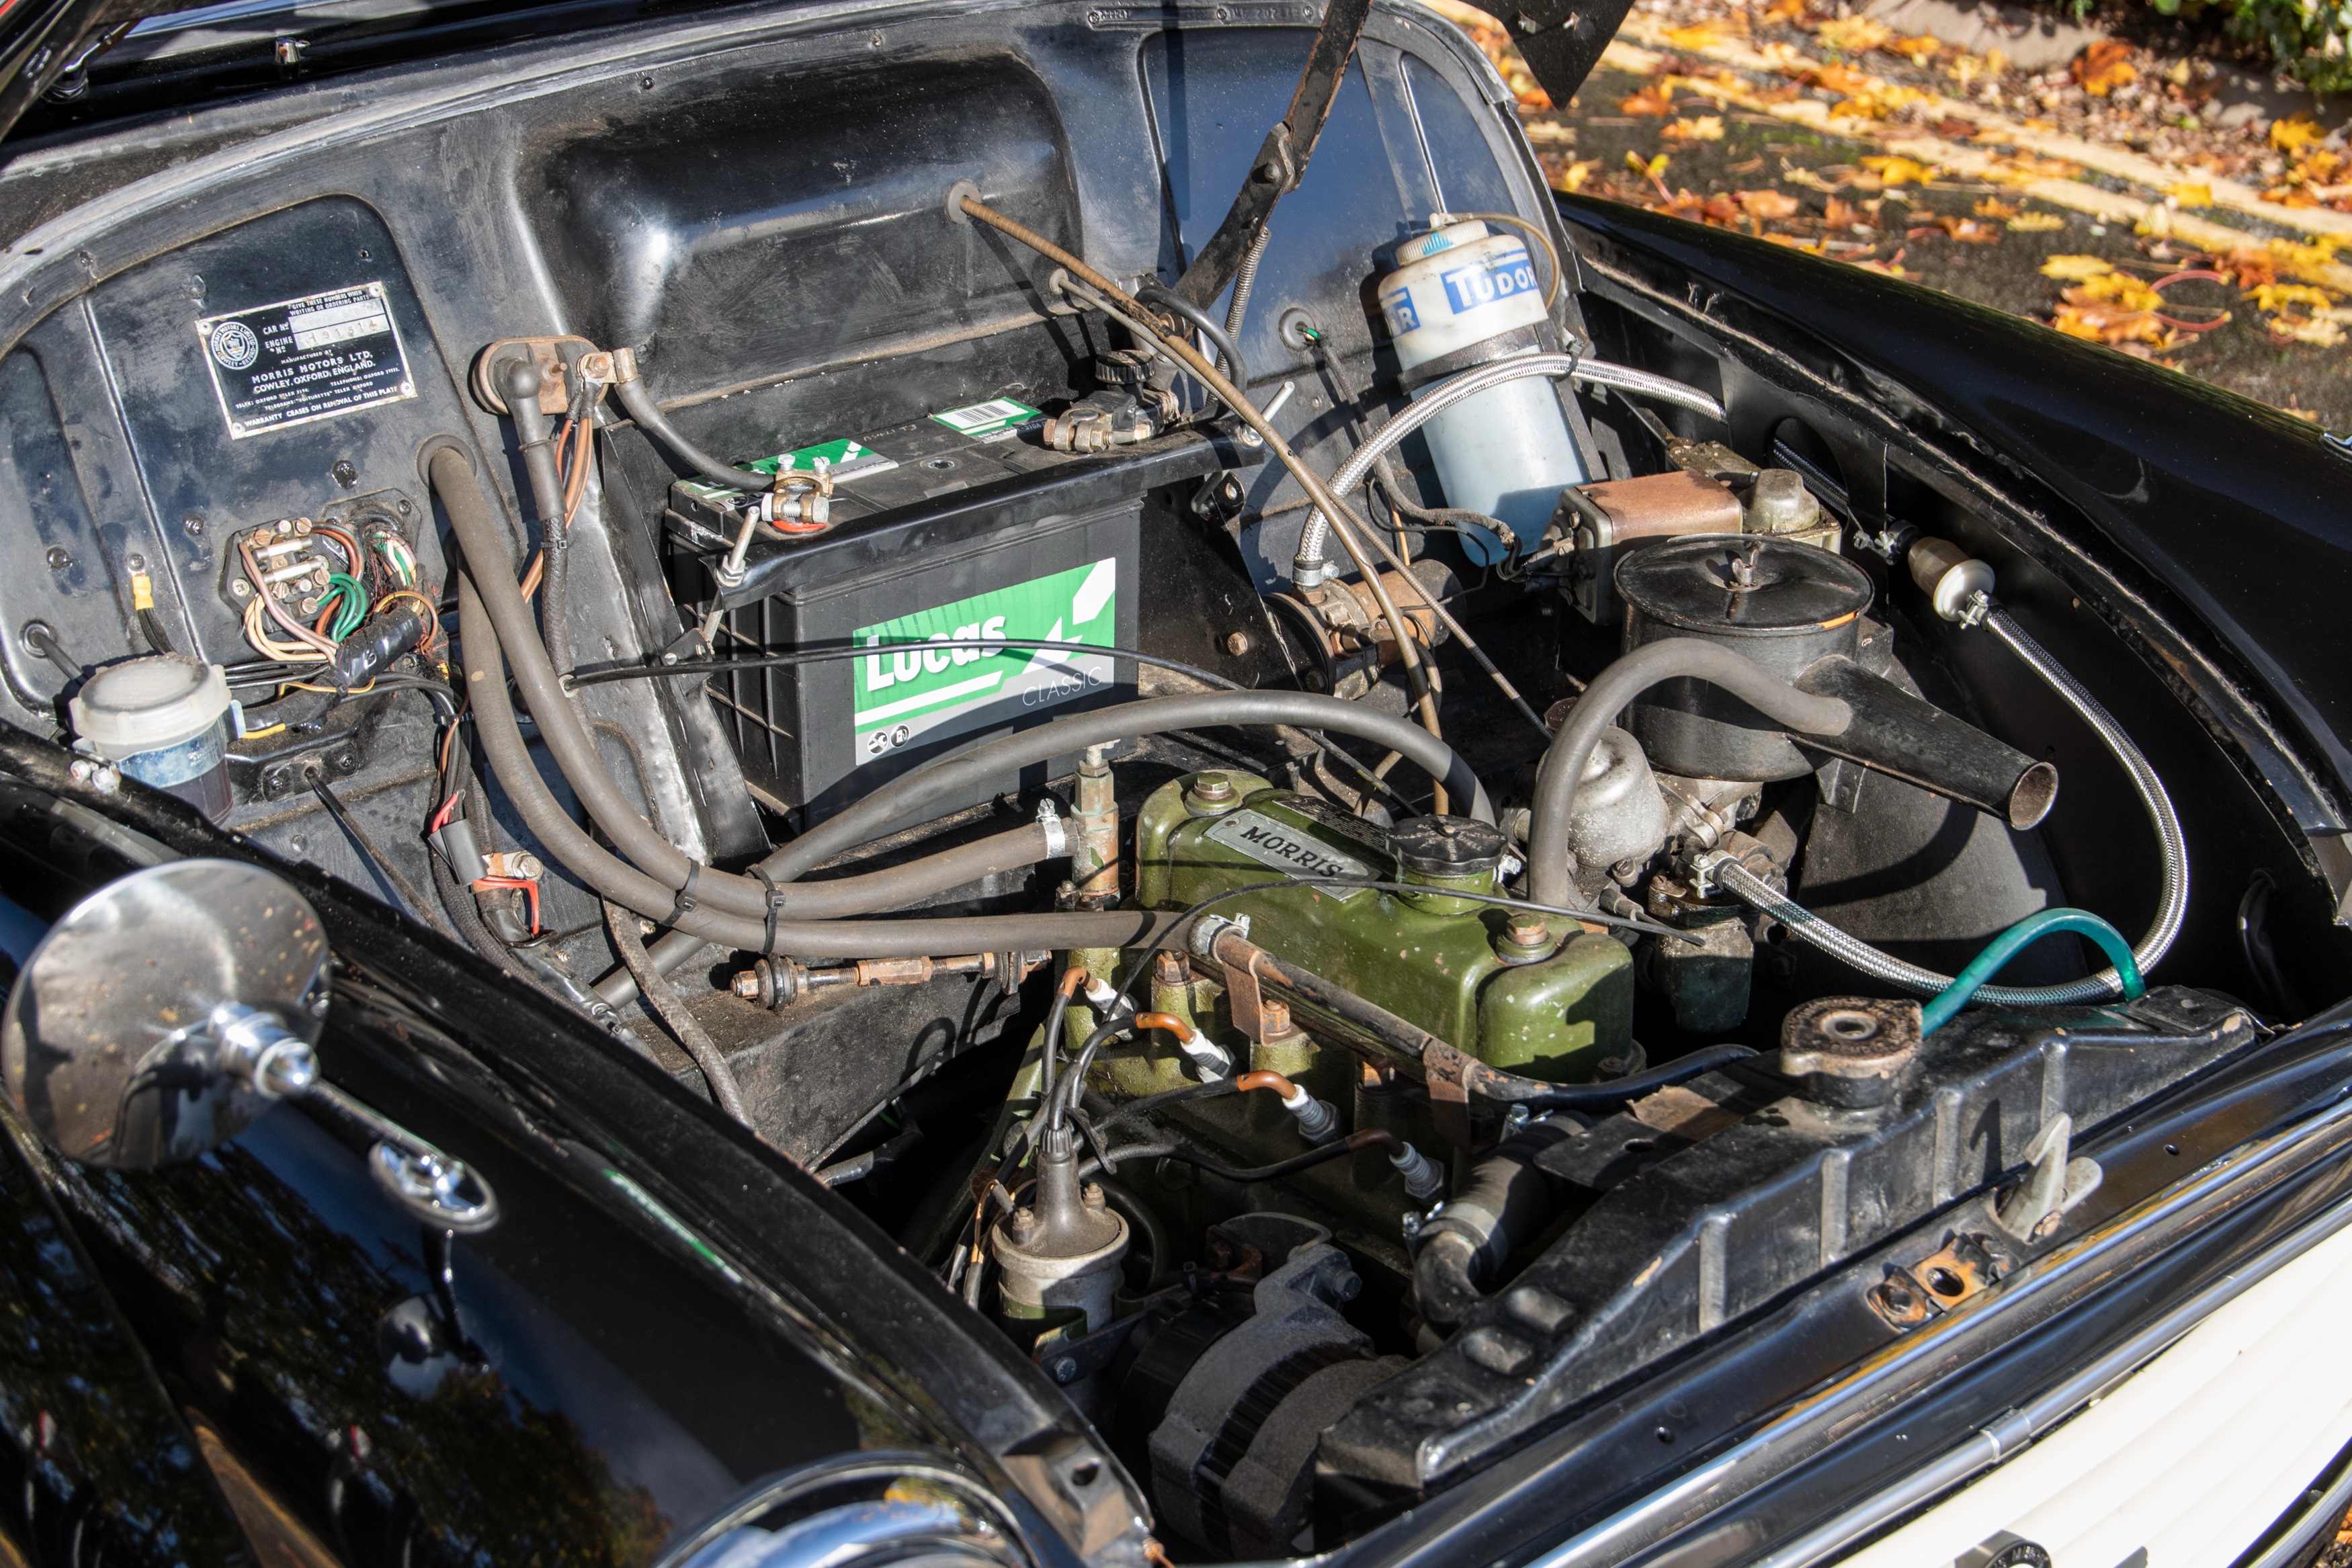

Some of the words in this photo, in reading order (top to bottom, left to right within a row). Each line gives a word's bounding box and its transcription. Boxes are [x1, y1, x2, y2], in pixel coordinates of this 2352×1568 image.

[1445, 265, 1538, 308] TUDOR
[290, 306, 315, 316] WRITING
[326, 298, 352, 309] ORDERING
[353, 294, 370, 303] PARTS
[292, 301, 305, 310] GIVE
[307, 297, 323, 306] THESE
[324, 292, 347, 302] NUMBERS
[347, 290, 363, 298] WHEN
[220, 324, 240, 334] MOTORS
[239, 326, 255, 347] LIMITED
[263, 325, 279, 335] CAR
[265, 335, 294, 349] ENGINE
[241, 347, 256, 365] OXFORD
[281, 351, 323, 365] MANUFACTURED
[252, 367, 294, 384] MORRIS
[299, 356, 344, 374] MOTORS
[330, 376, 363, 386] TELEPHONE:
[364, 370, 385, 380] OXFORD
[332, 360, 376, 376] ENGLAND.
[334, 386, 351, 394] TELEX
[352, 381, 374, 390] OXFORD
[244, 412, 283, 427] WARRANTY
[286, 406, 310, 417] CEASES
[311, 403, 323, 412] ON
[323, 396, 353, 409] REMOVAL
[353, 394, 363, 402] OF
[362, 390, 378, 400] THIS
[255, 395, 278, 404] OXFORD
[866, 616, 1007, 692] Lucas
[1023, 666, 1103, 707] CLASSIC
[1239, 826, 1344, 877] MORRIS
